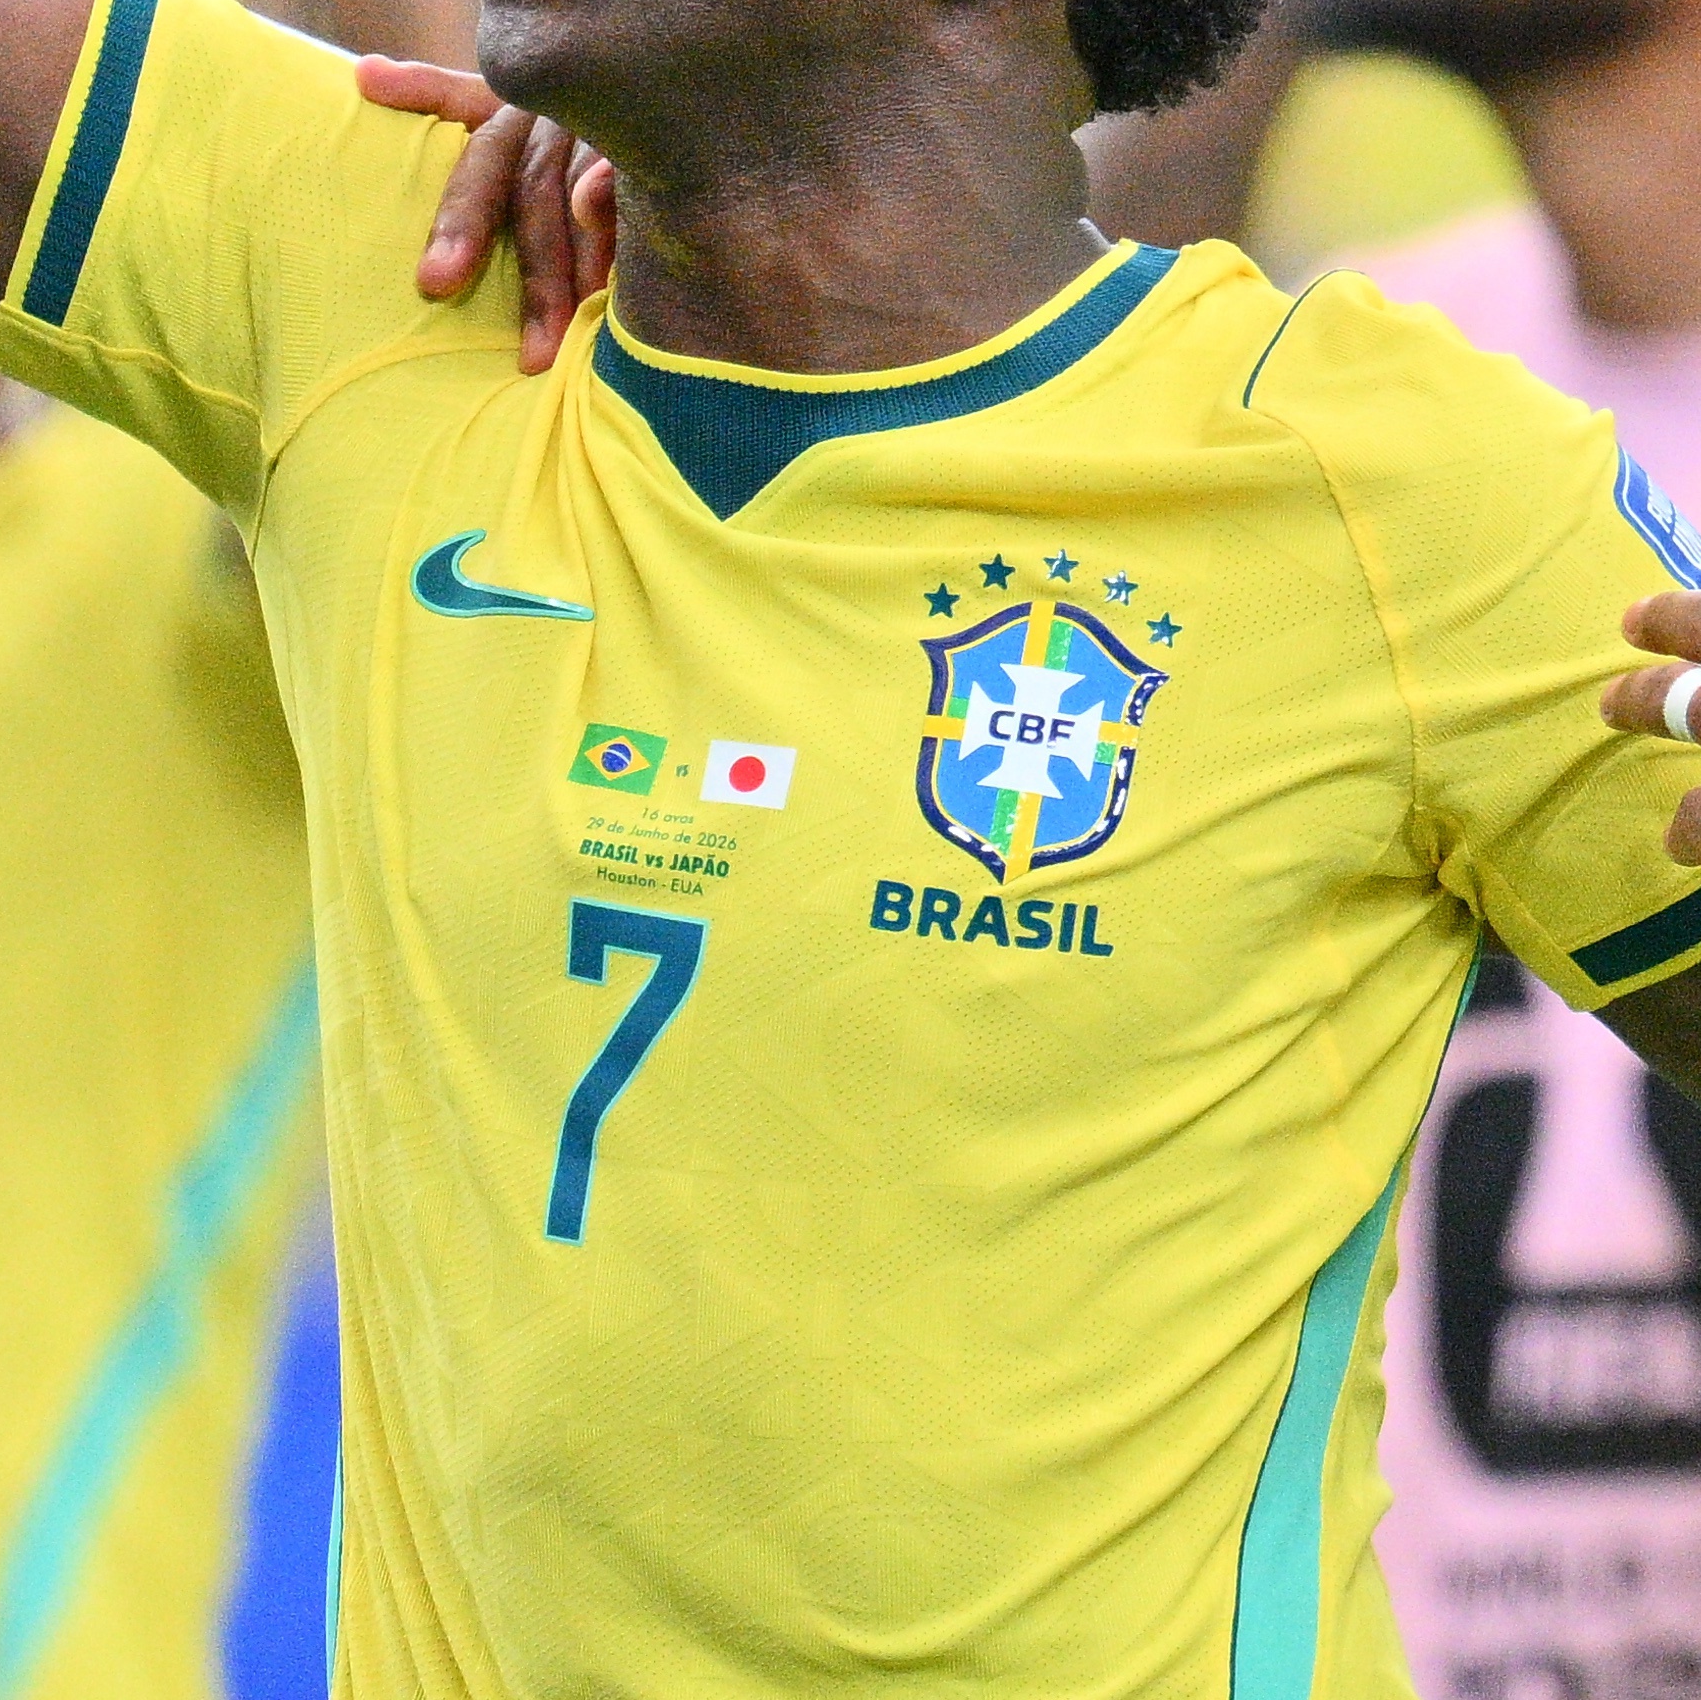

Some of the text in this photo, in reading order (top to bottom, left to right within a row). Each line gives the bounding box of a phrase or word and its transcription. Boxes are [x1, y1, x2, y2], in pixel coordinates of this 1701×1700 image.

[988, 710, 1076, 749] CBF
[586, 816, 737, 851] 29 de Junho de 2026
[642, 807, 695, 825] 16 avos
[596, 866, 657, 888] Houston
[670, 878, 704, 896] EUA
[644, 853, 664, 869] vs
[669, 853, 730, 878] JAPÃO
[869, 879, 1115, 957] BRASIL
[545, 897, 709, 1245] 7
